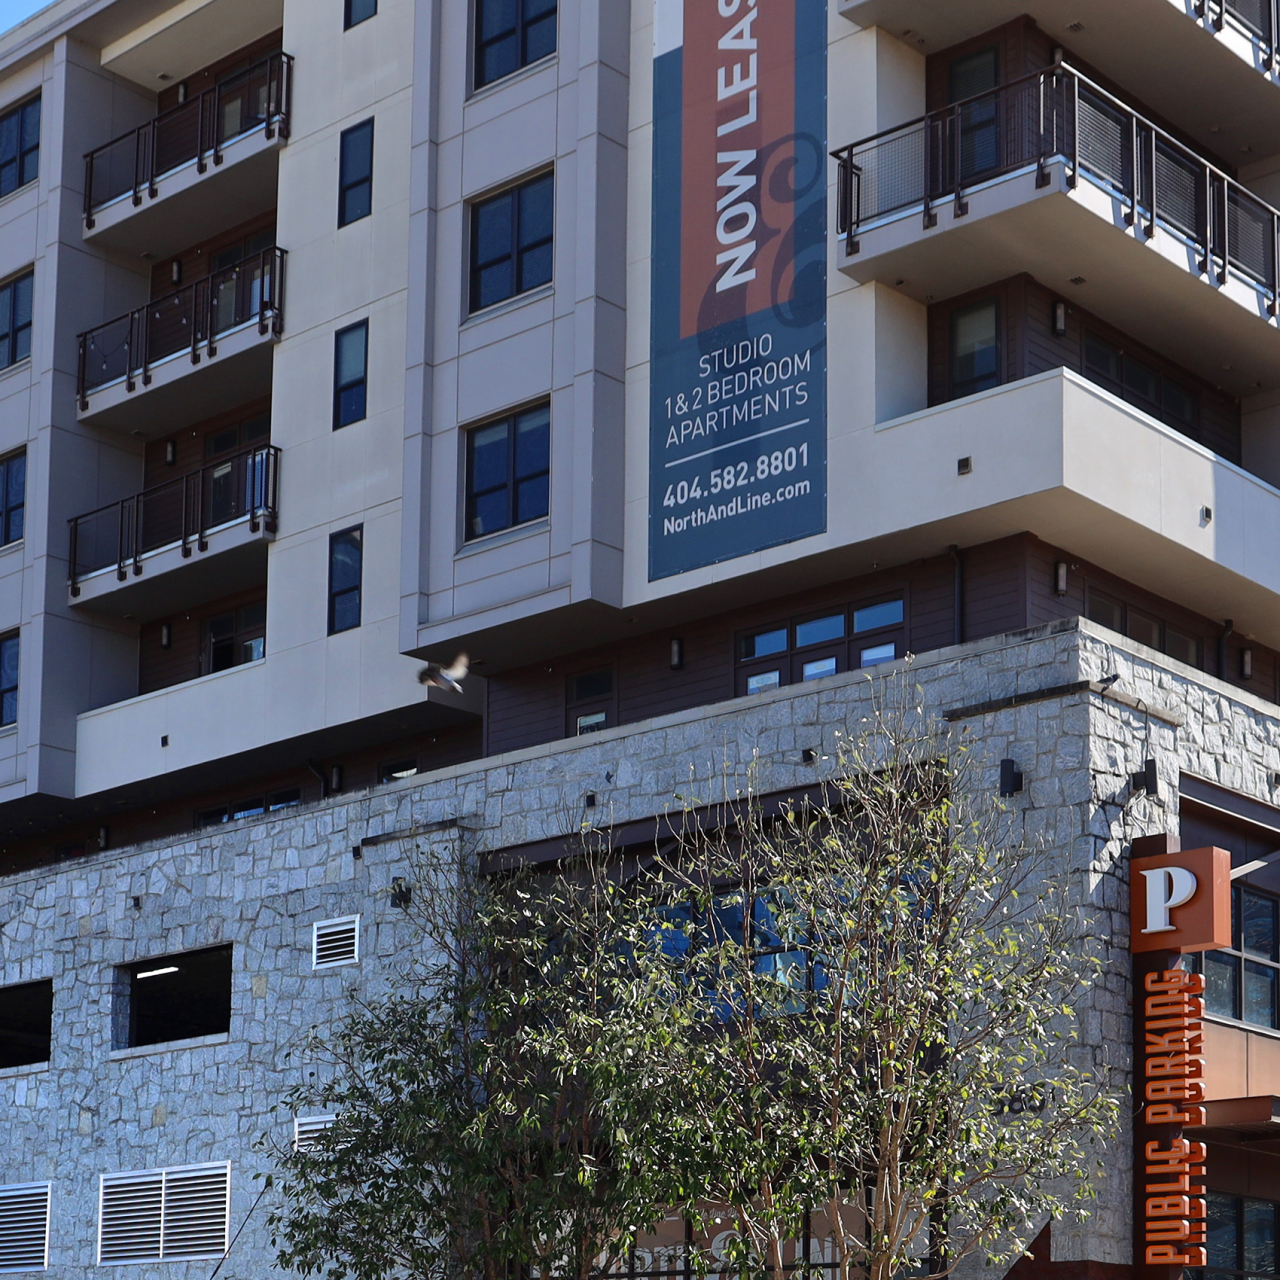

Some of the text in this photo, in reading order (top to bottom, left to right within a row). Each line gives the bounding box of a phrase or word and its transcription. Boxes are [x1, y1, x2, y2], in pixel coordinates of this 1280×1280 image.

[715, 149, 757, 293] NOW
[699, 333, 773, 378] STUDIO
[708, 350, 811, 405] BEDROOM
[665, 381, 809, 449] APARTMENTS
[663, 442, 808, 508] 404.582.8801
[663, 480, 811, 536] NorthAndLine.com
[1139, 866, 1198, 935] P
[1145, 969, 1190, 1264] PUBLIC PARKING
